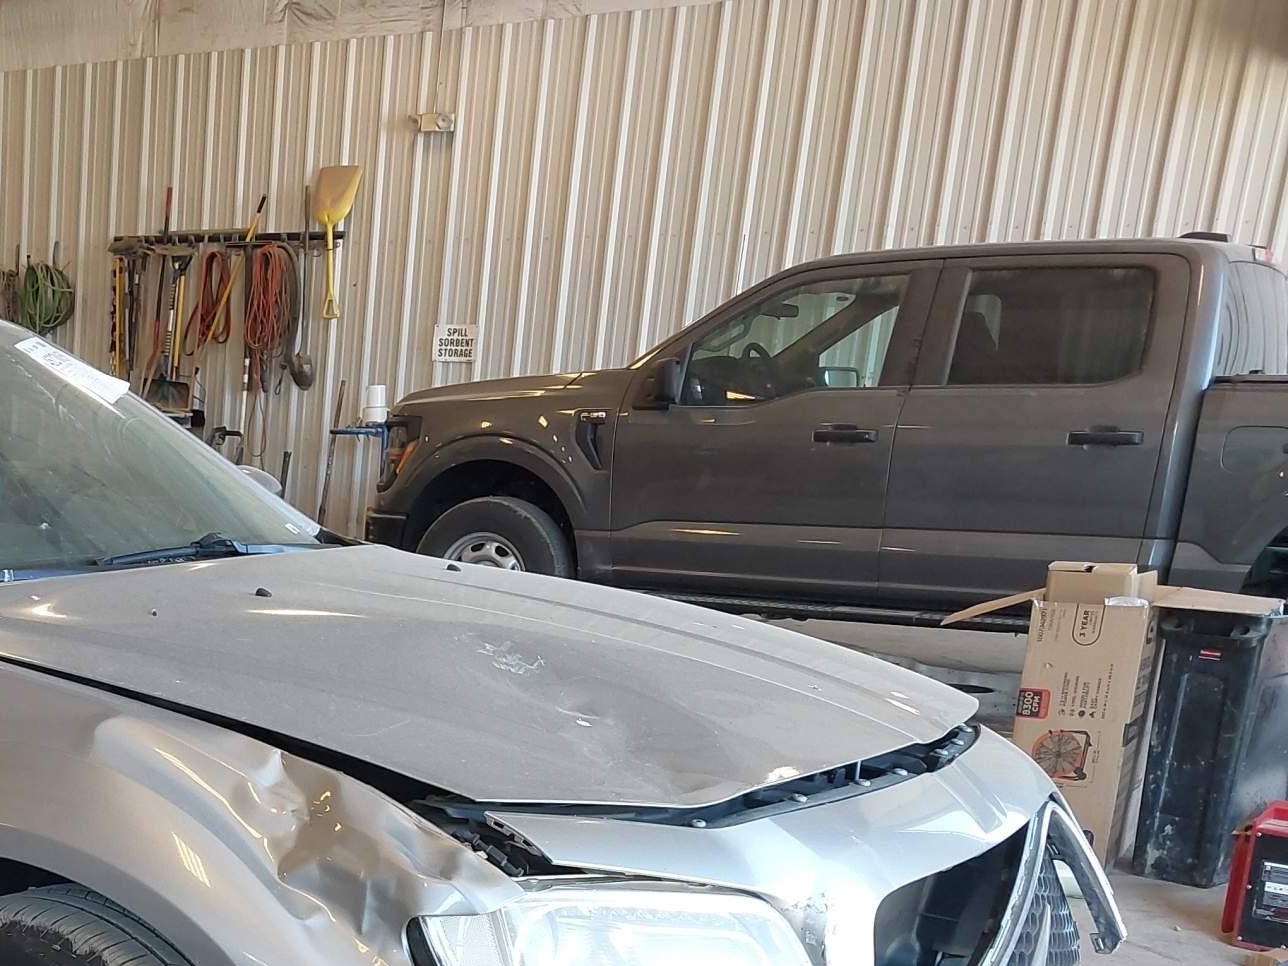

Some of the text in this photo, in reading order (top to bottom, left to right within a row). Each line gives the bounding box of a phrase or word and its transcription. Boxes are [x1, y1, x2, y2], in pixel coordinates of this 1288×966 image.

[447, 327, 468, 337] SPILL
[438, 337, 474, 348] SORBENT
[437, 348, 473, 358] STORAGE
[1080, 610, 1089, 630] YEAR
[1022, 691, 1033, 716] 8300
[1032, 695, 1041, 712] CFM
